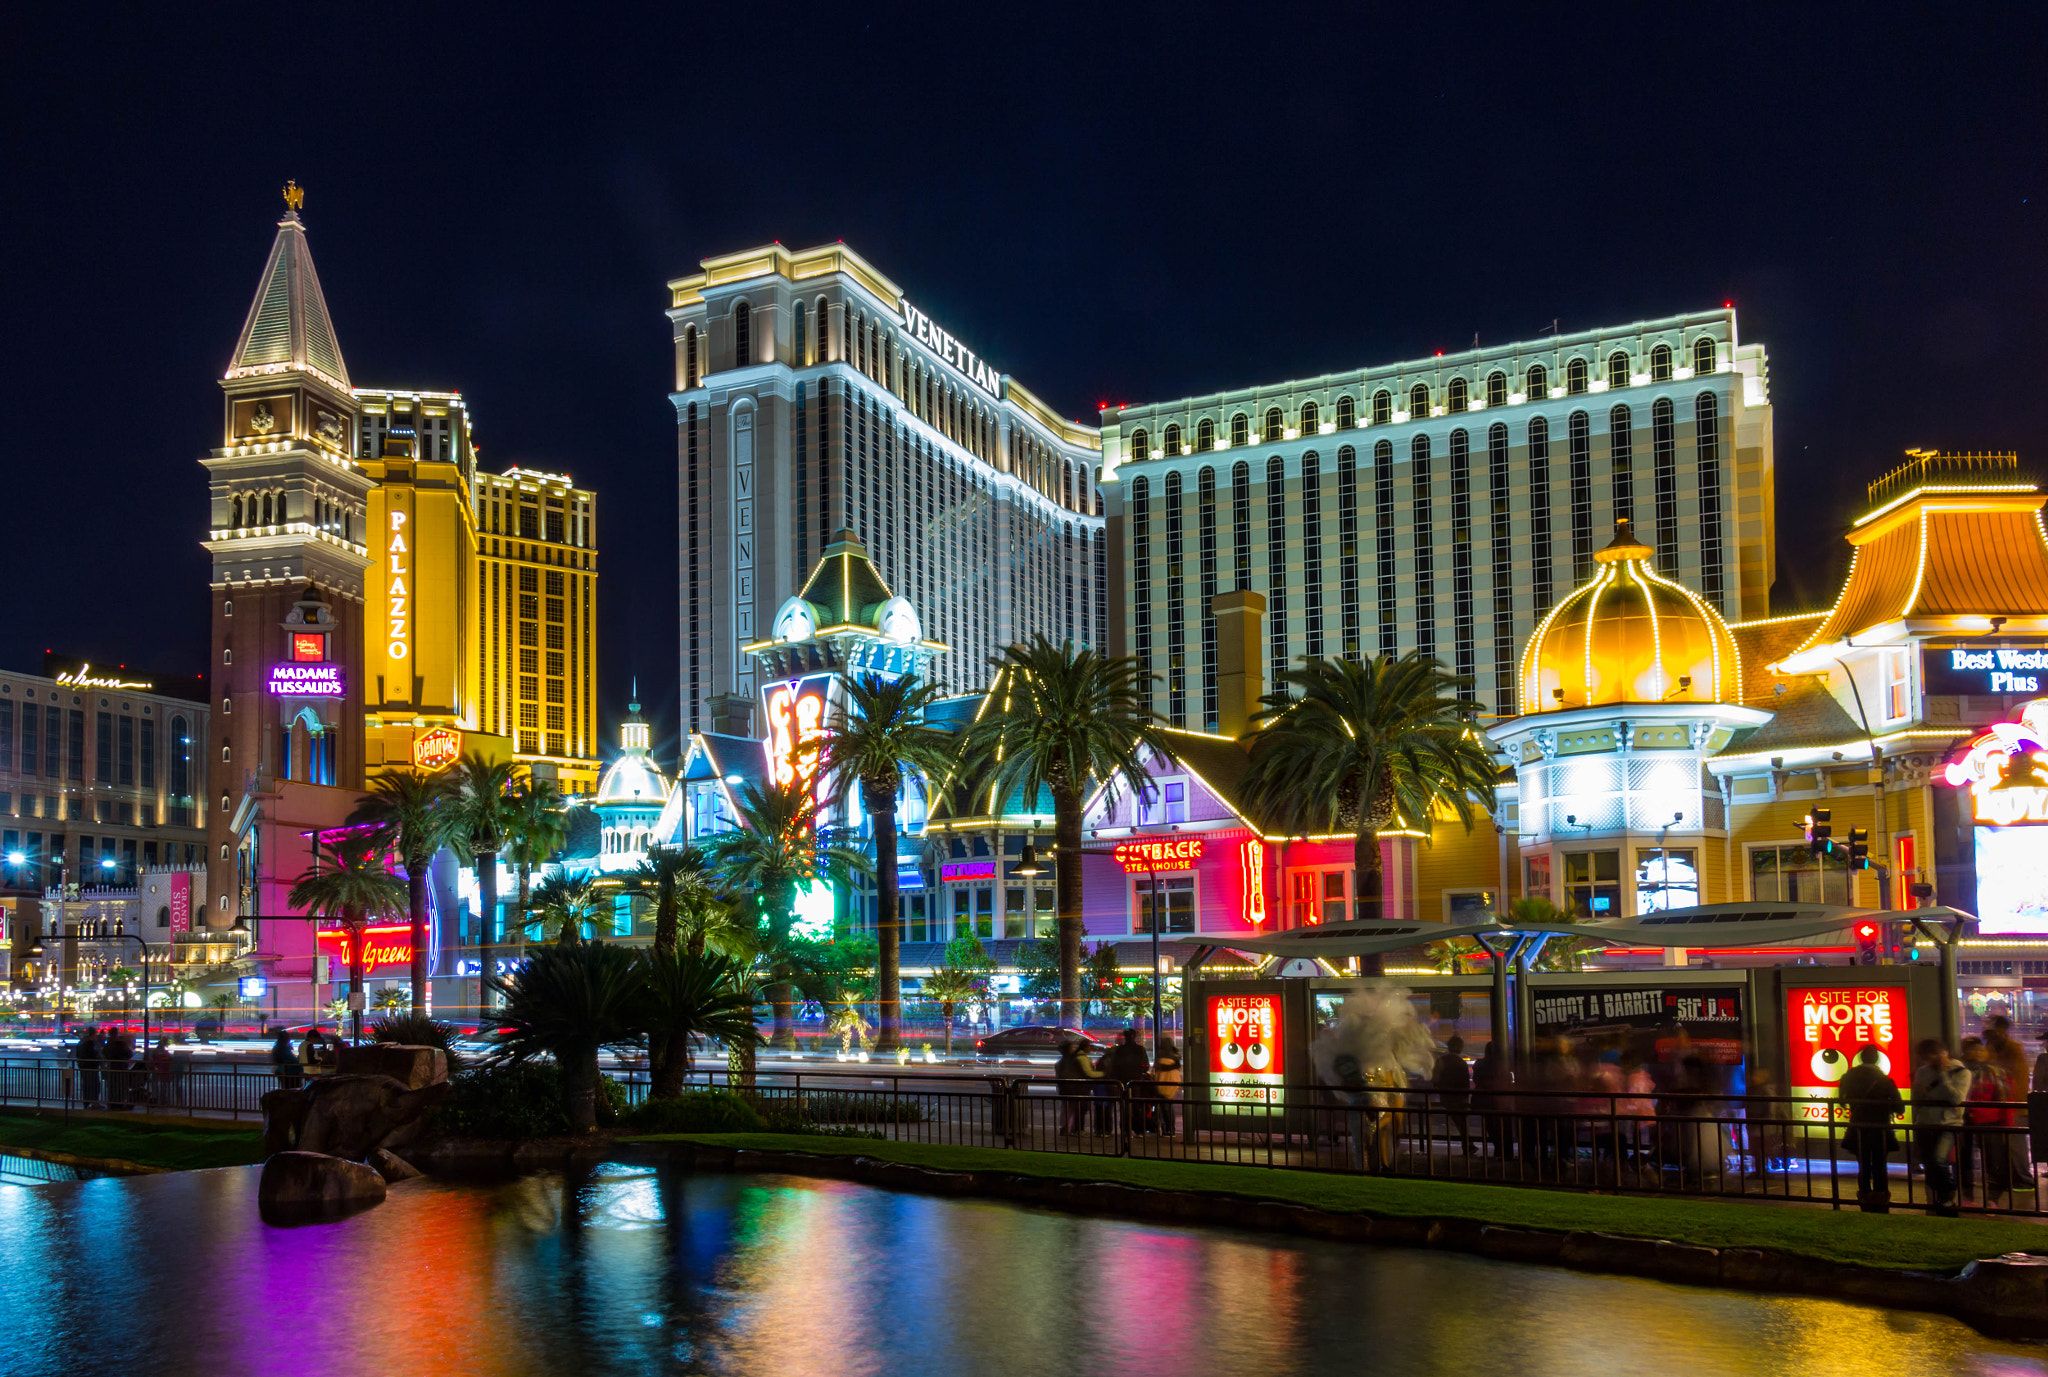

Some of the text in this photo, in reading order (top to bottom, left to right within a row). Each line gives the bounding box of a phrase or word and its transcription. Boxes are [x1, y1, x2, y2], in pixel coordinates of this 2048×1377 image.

[902, 298, 1000, 399] VENETIAN
[388, 510, 407, 660] PALAZZO
[739, 470, 750, 700] VENETIA
[1951, 649, 1995, 670] Best
[273, 667, 338, 680] MADAME
[1990, 671, 2038, 692] Plus
[1115, 840, 1202, 863] OUTBACK
[942, 862, 996, 877] FAT TUESDAY
[340, 941, 411, 973] Wlgreens
[1218, 998, 1270, 1007] A SITE FOR
[1535, 990, 1664, 1025] SHOOT A BARRETT
[1804, 991, 1889, 1003] A SITE FOR
[1217, 1008, 1271, 1025] MORE
[1803, 1004, 1891, 1025] MORE
[1214, 1088, 1277, 1099] 702.932.488
